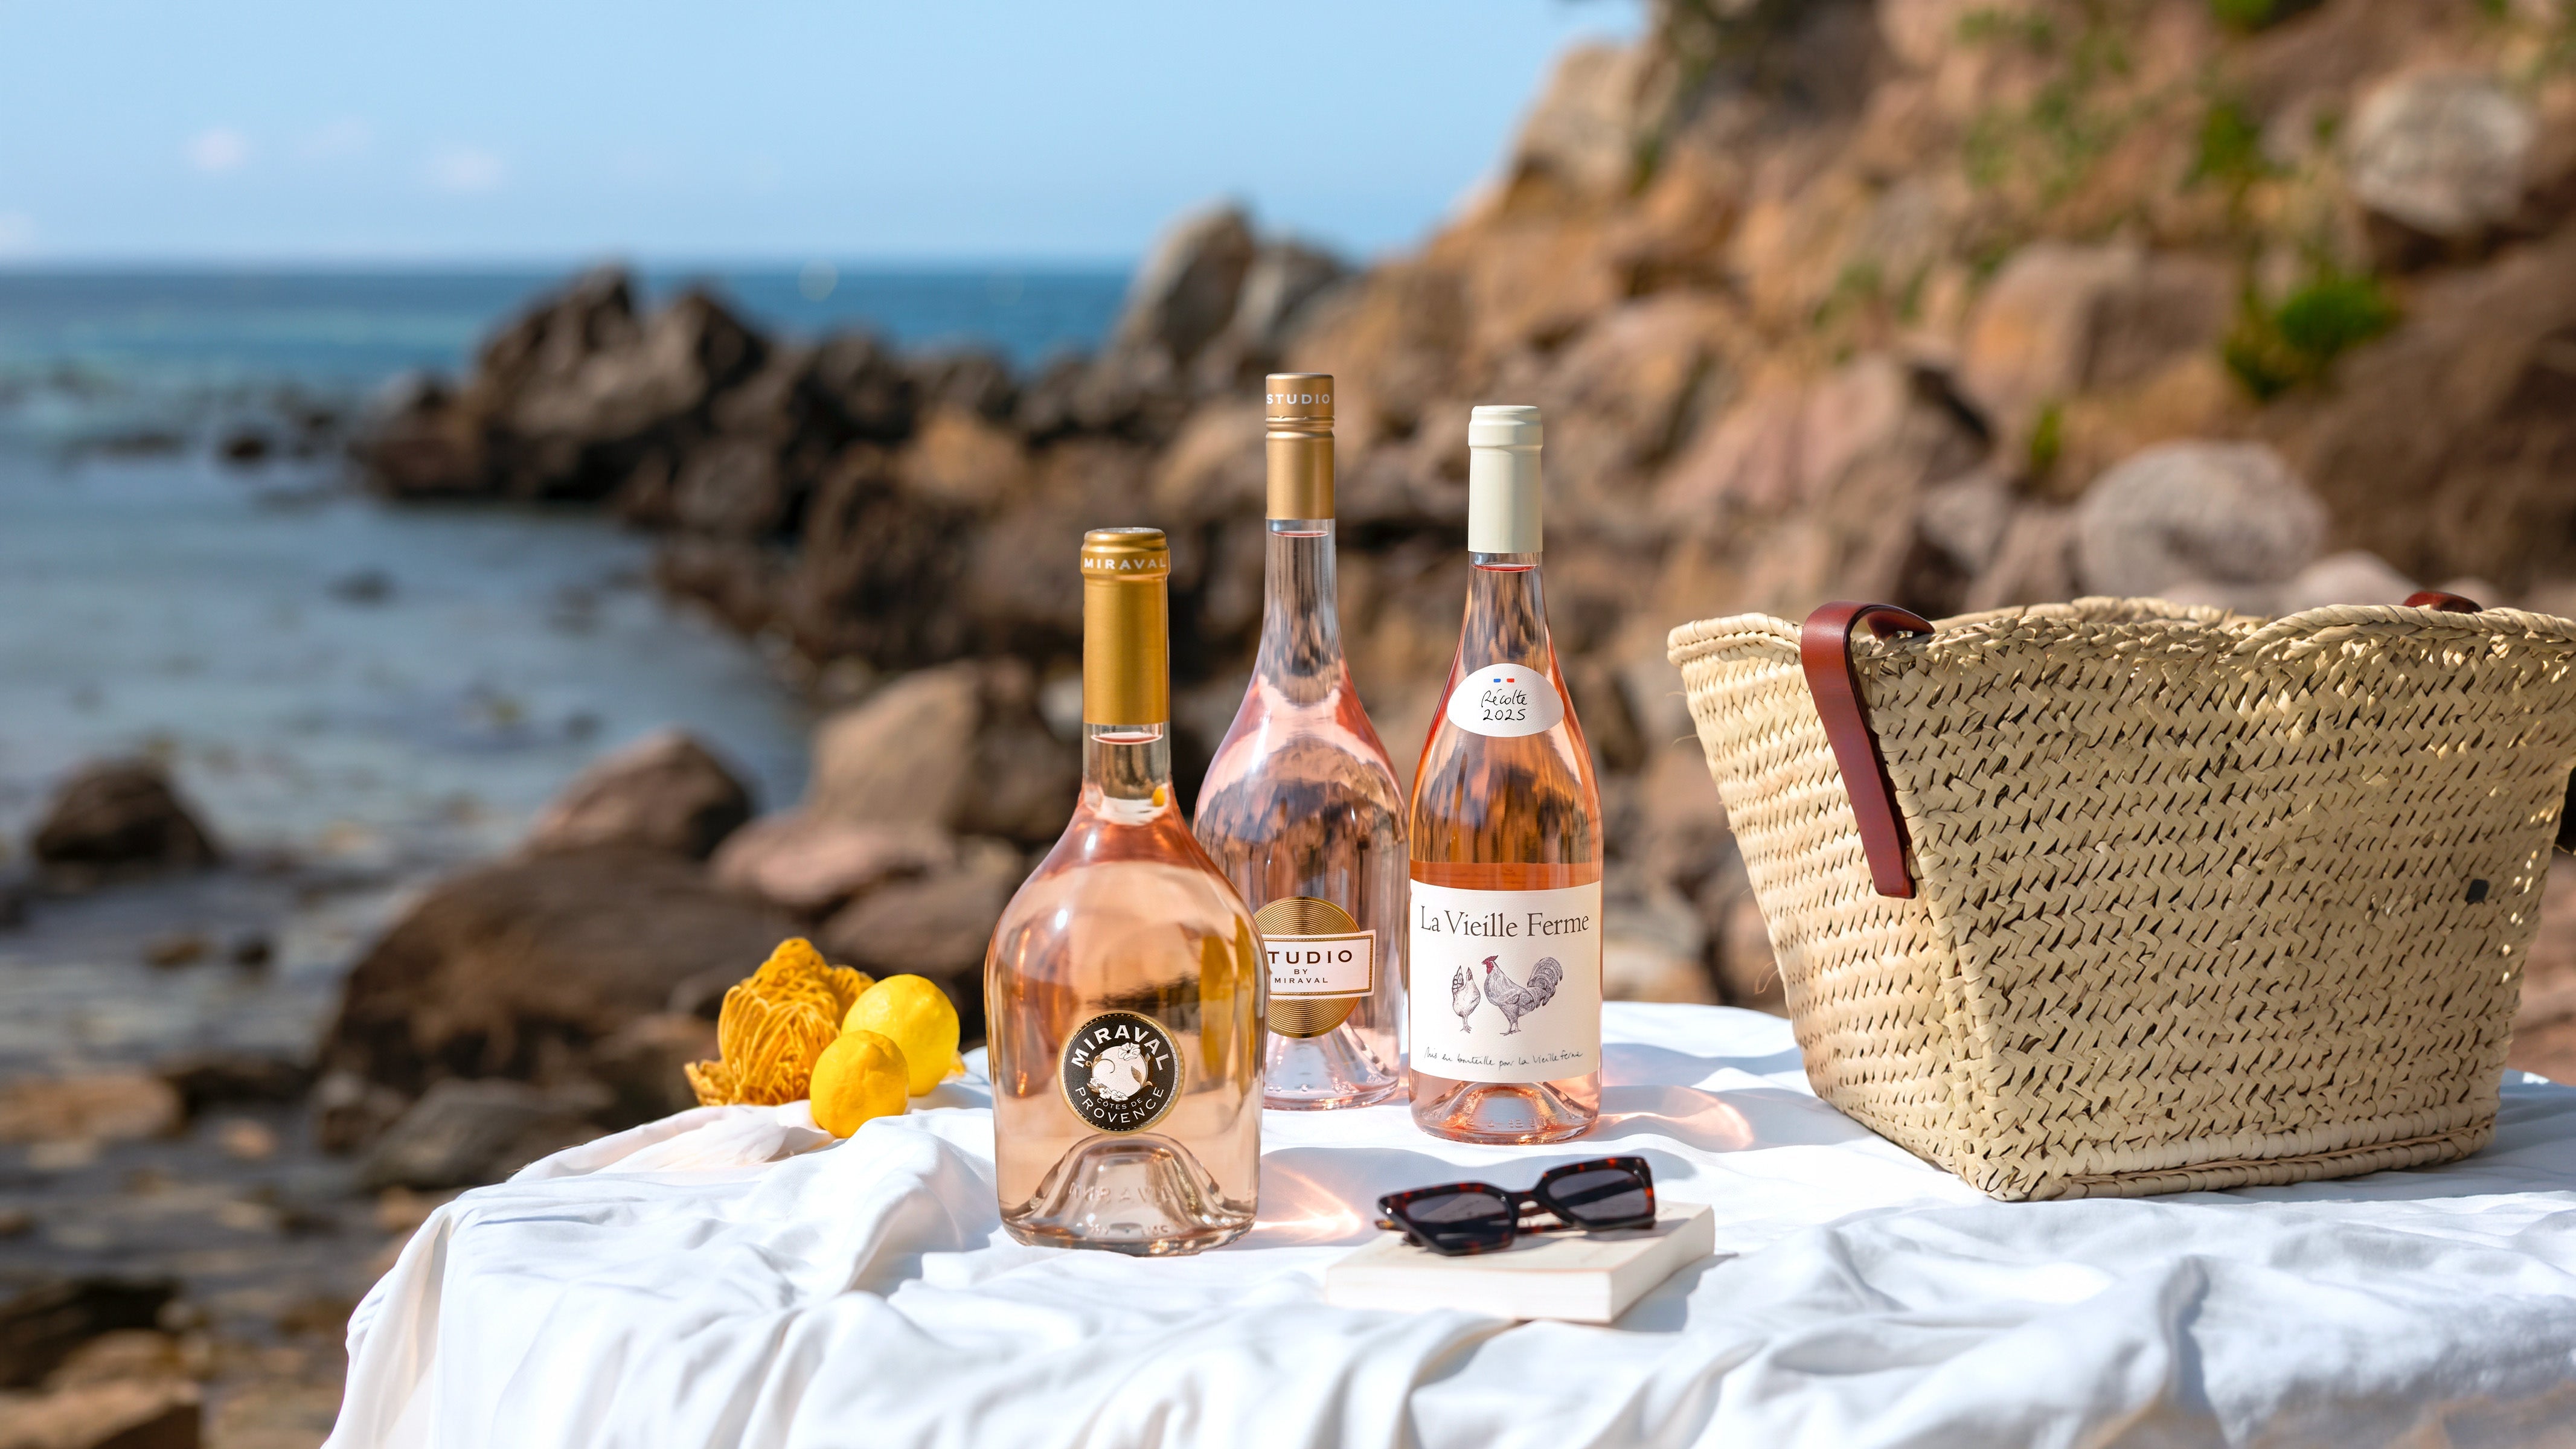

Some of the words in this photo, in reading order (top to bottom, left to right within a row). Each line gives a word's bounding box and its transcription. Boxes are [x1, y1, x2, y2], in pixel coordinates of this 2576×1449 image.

[1266, 393, 1330, 405] STUDIO
[1084, 557, 1167, 571] MIRAVAL
[1481, 688, 1528, 708] Récolte
[1482, 709, 1526, 721] 2025
[1420, 905, 1441, 932] La
[1444, 910, 1518, 937] Vieille
[1527, 912, 1589, 936] Ferme
[1267, 950, 1353, 964] TUDIO
[1071, 1025, 1170, 1071] MIRAVAL
[1074, 1086, 1165, 1124] PROVENCE
[1097, 1097, 1127, 1110] CÔTES
[1130, 1097, 1143, 1107] DE
